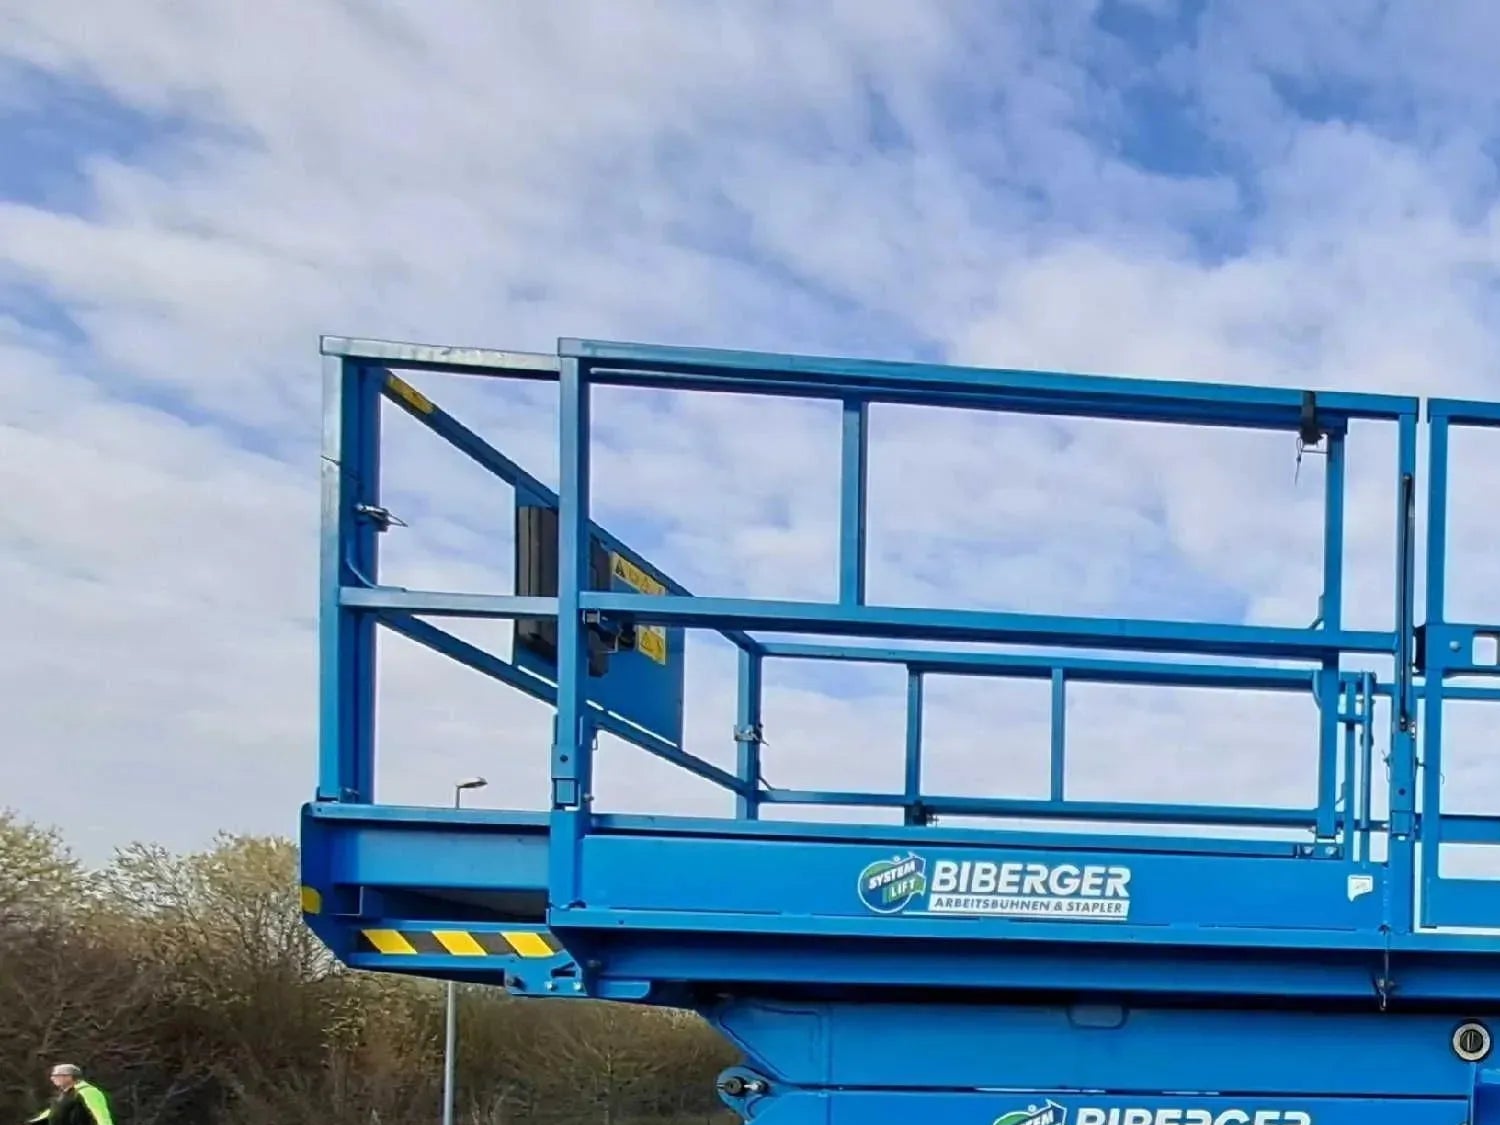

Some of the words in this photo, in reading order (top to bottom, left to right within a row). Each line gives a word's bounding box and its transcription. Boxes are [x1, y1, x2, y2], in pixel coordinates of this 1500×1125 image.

[869, 860, 915, 890] SYSTEM
[931, 860, 1131, 897] BIBERGER
[891, 878, 915, 897] LIFT
[1066, 901, 1123, 914] STAPLER
